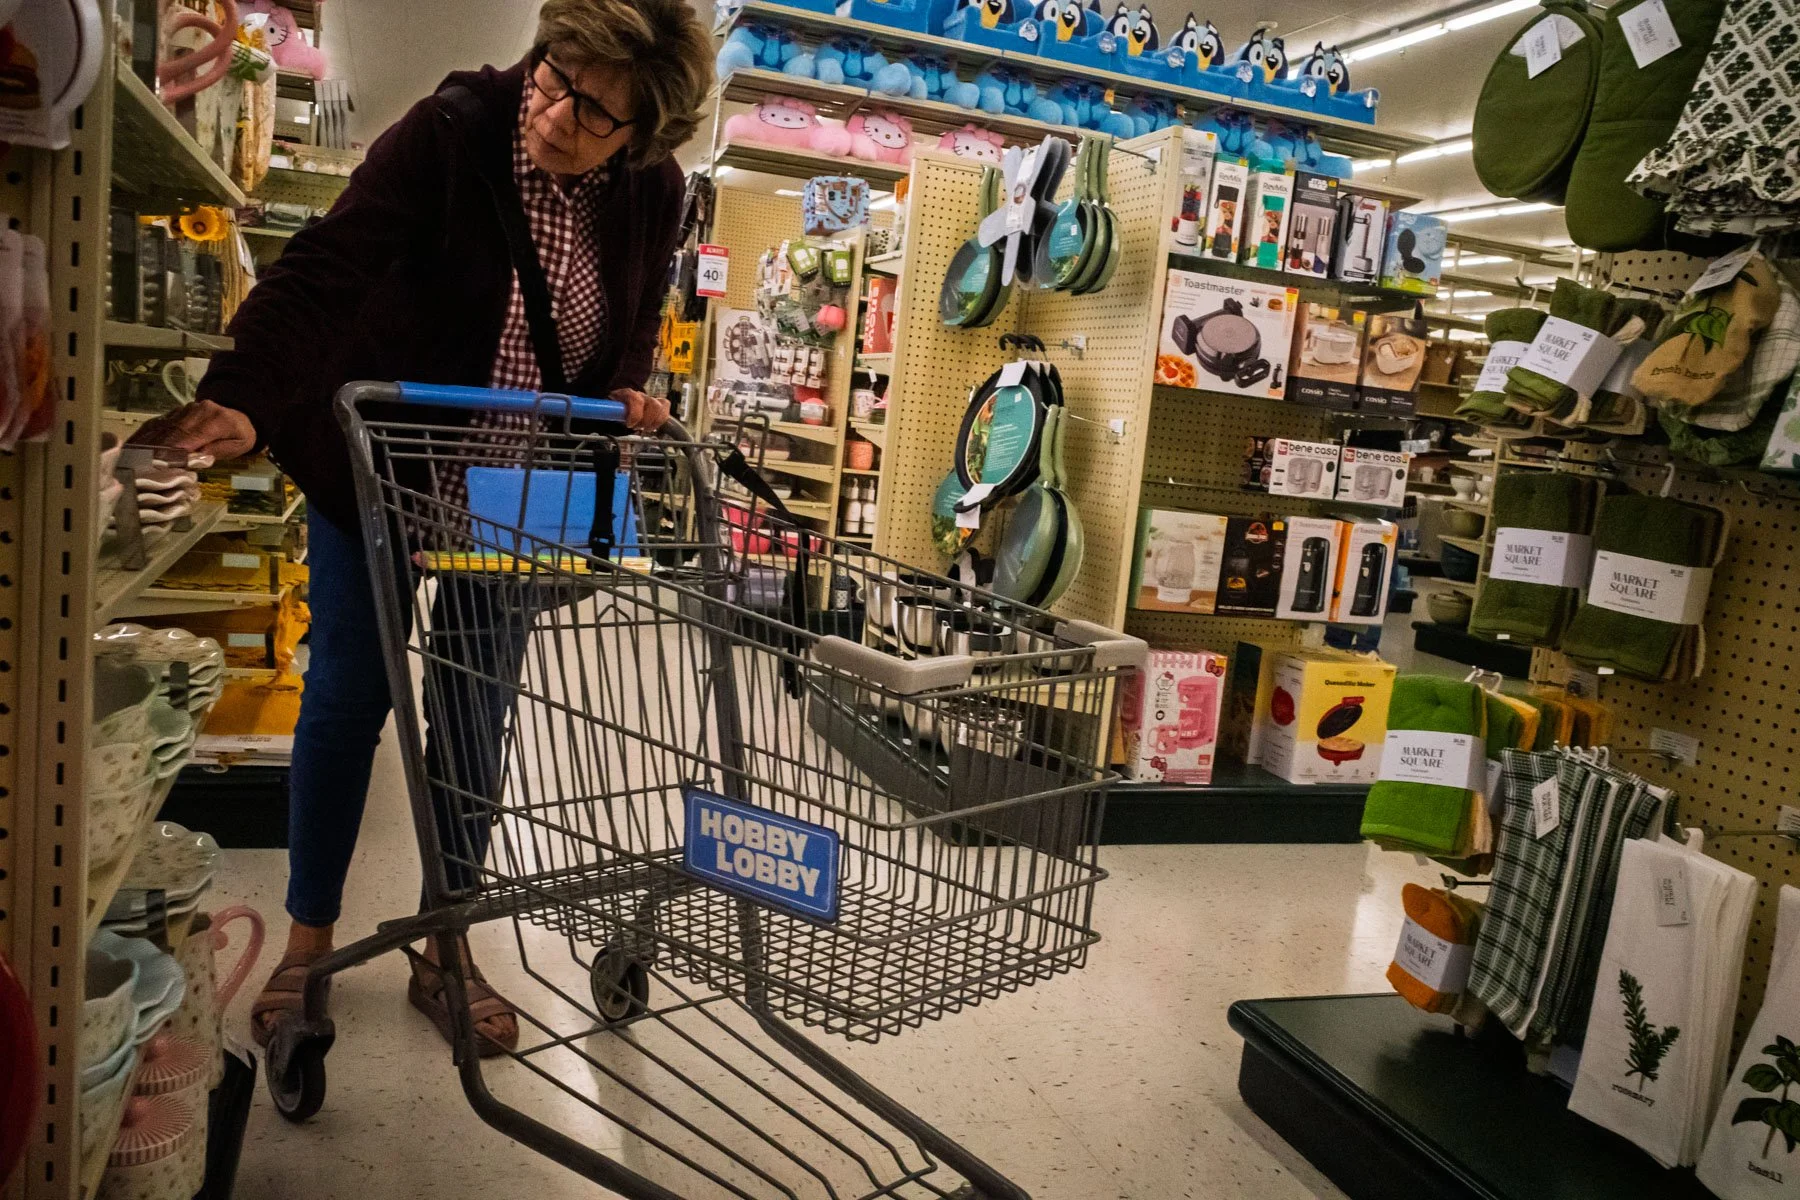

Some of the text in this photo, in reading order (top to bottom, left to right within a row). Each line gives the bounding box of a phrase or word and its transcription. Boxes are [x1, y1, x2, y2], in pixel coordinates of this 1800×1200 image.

[1262, 181, 1288, 192] RevMix
[703, 269, 719, 281] 40
[1183, 278, 1244, 296] Toastmaster
[1545, 333, 1578, 351] MARKET
[1538, 343, 1572, 361] SQUARE
[1289, 442, 1338, 456] bene casa
[1356, 450, 1381, 461] bene
[1506, 544, 1544, 556] MARKET
[1503, 553, 1542, 566] SQUARE
[1613, 571, 1660, 589] MARKET
[1609, 581, 1657, 600] SQUARE
[1403, 746, 1445, 758] MARKET
[1400, 756, 1444, 768] SQUARE
[700, 807, 808, 863] HOBBY
[716, 841, 820, 898] LOBBY
[1406, 934, 1436, 959] MARKET
[1404, 945, 1433, 968] SQUARE
[1611, 1083, 1656, 1107] rosemary
[1747, 1160, 1784, 1184] basil
